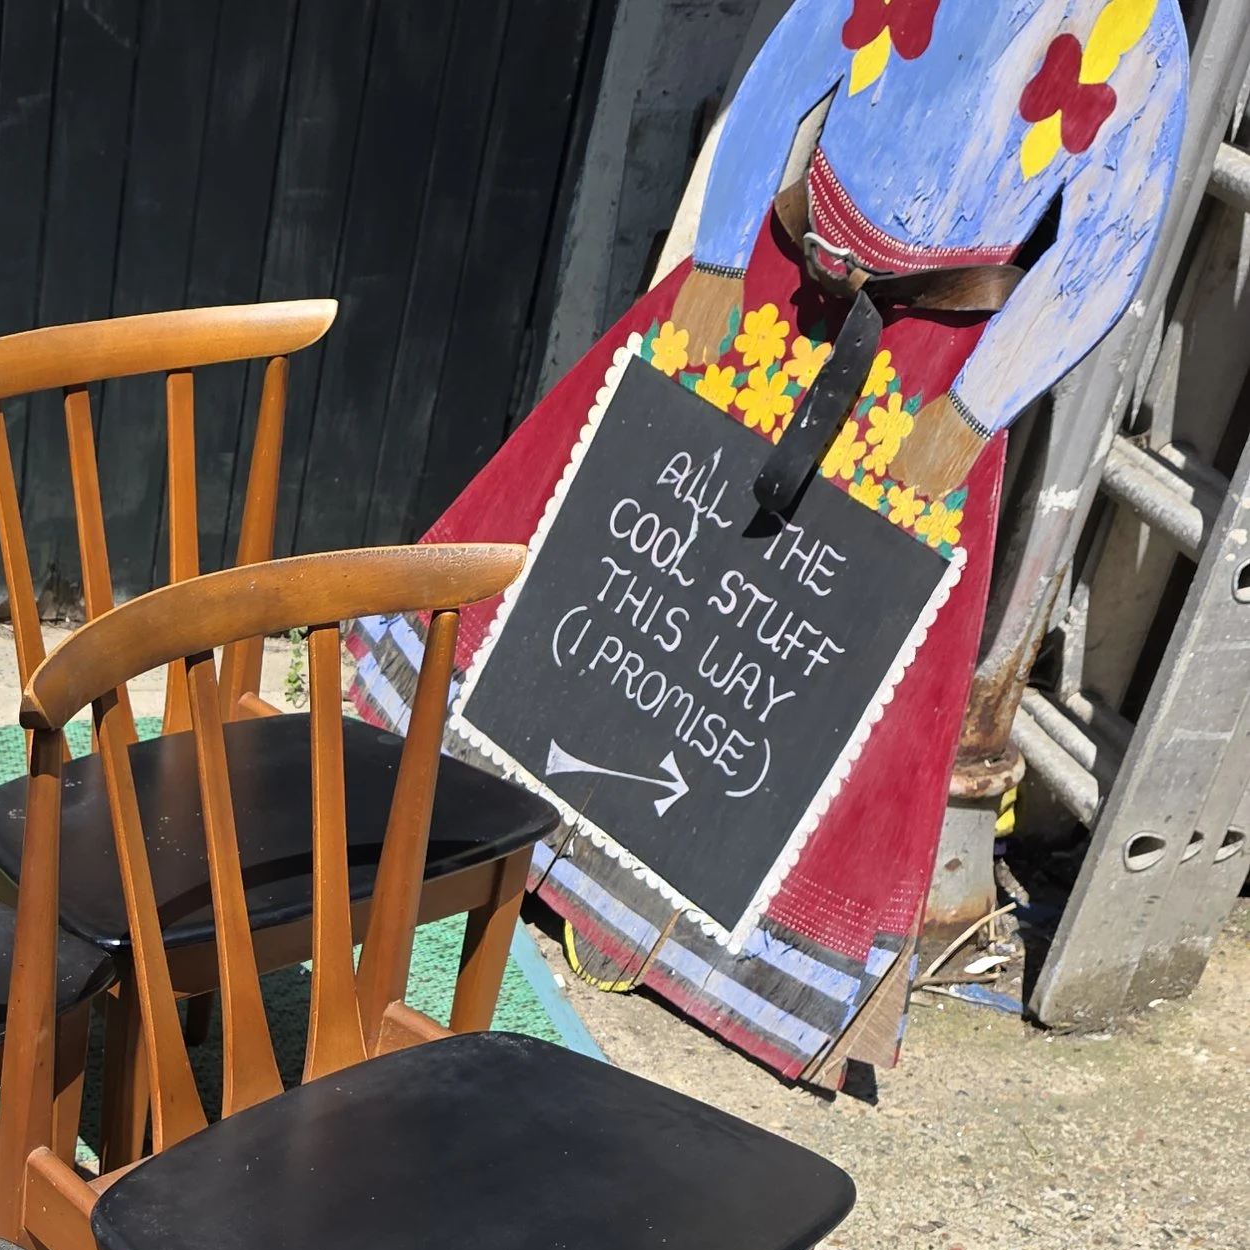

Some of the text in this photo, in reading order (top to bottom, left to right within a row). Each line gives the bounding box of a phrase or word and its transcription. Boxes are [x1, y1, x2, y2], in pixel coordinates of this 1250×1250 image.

[608, 497, 845, 677] COOL STUFF
[656, 450, 847, 597] ALL THE
[552, 605, 772, 798] (I PROMISE)
[596, 556, 796, 724] THIS WAY
